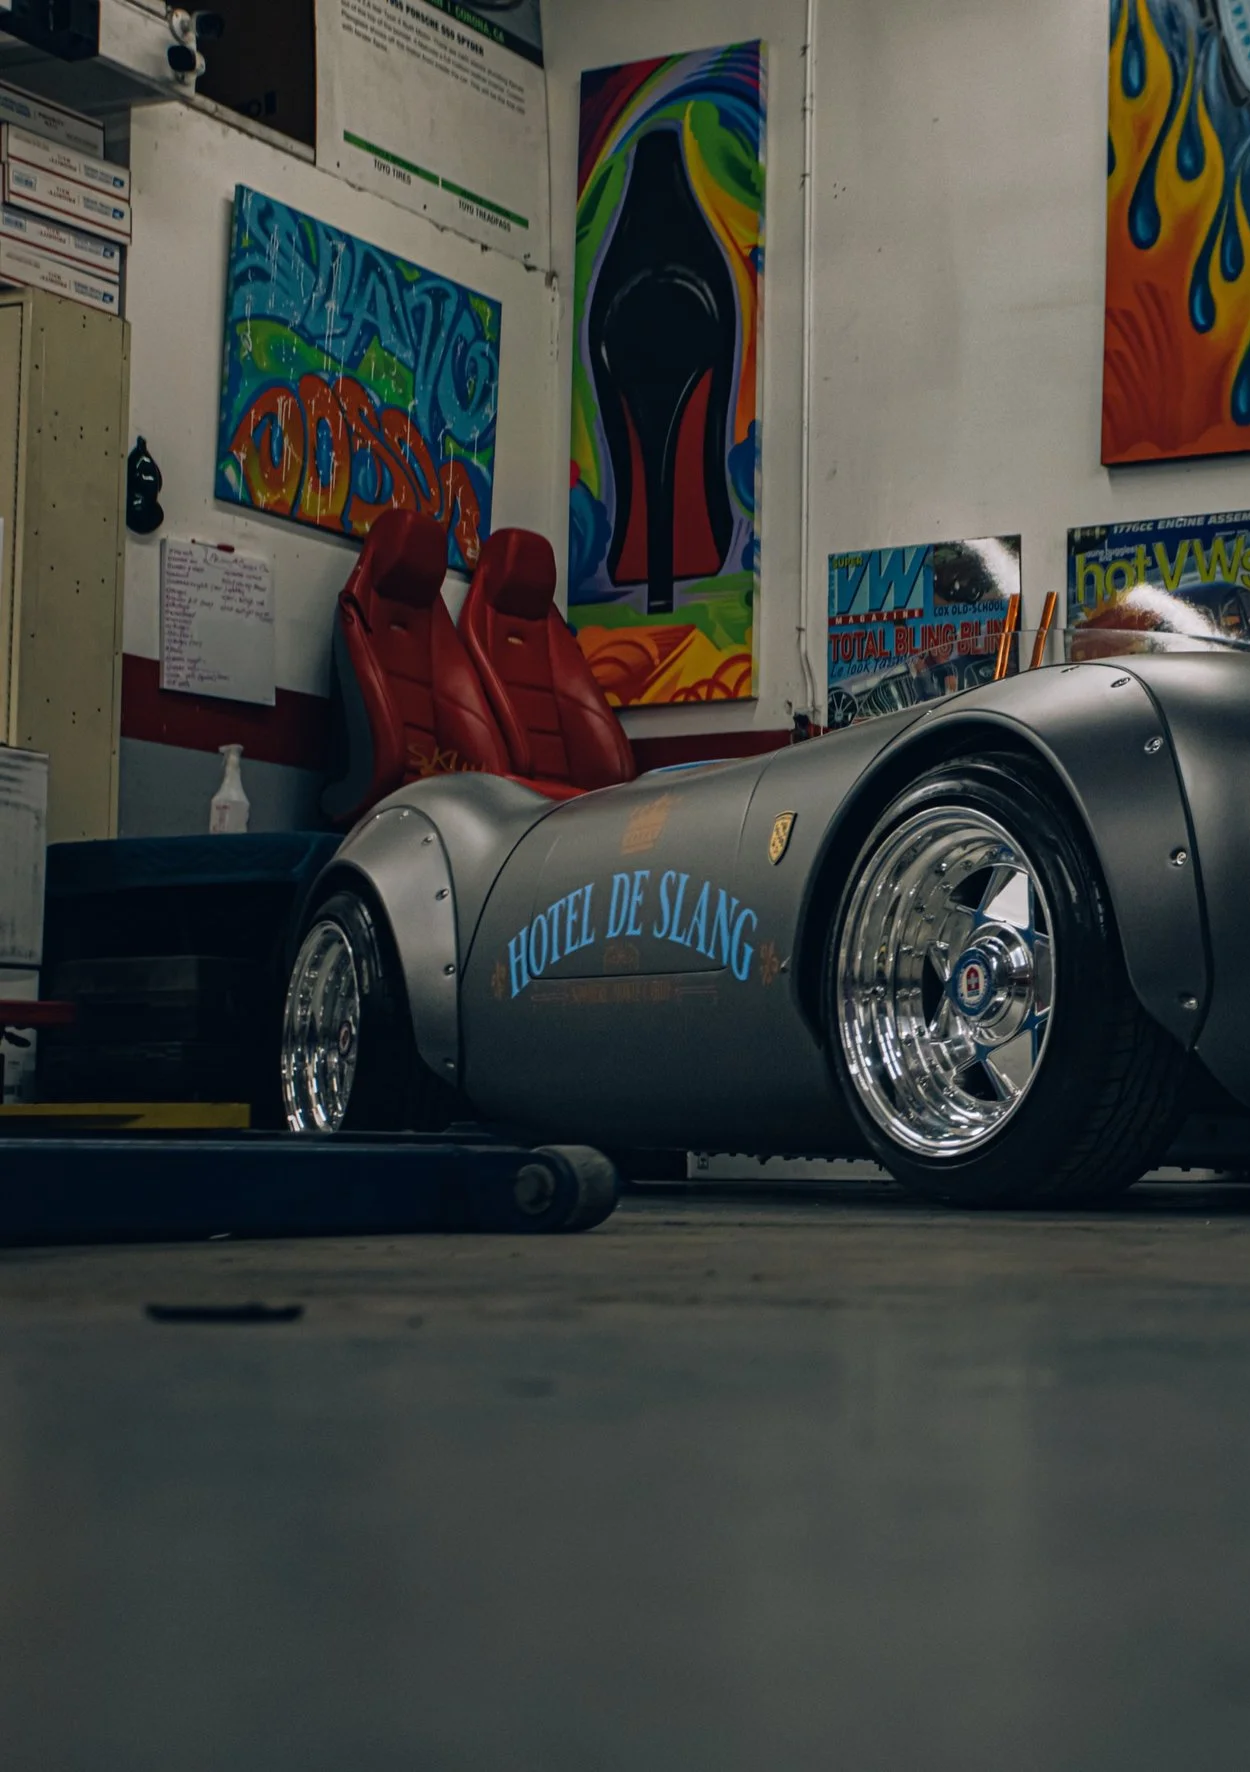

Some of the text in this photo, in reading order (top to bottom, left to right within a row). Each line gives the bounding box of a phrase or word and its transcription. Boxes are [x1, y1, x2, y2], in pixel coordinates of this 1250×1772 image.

[406, 2, 440, 31] PORSCHE
[457, 33, 485, 57] SPYDER
[373, 158, 391, 176] TOYO
[392, 168, 412, 186] TIRES
[1157, 516, 1205, 530] ENGINE
[1075, 545, 1152, 604] hot
[835, 609, 921, 625] MAGAZINE
[933, 600, 1006, 618] COX OLD-SCHOOL
[828, 630, 891, 663] TOTAL
[894, 623, 958, 659] BLING
[831, 661, 846, 678] Le
[846, 658, 871, 675] look
[507, 869, 759, 999] HOTEL DE SLANG
